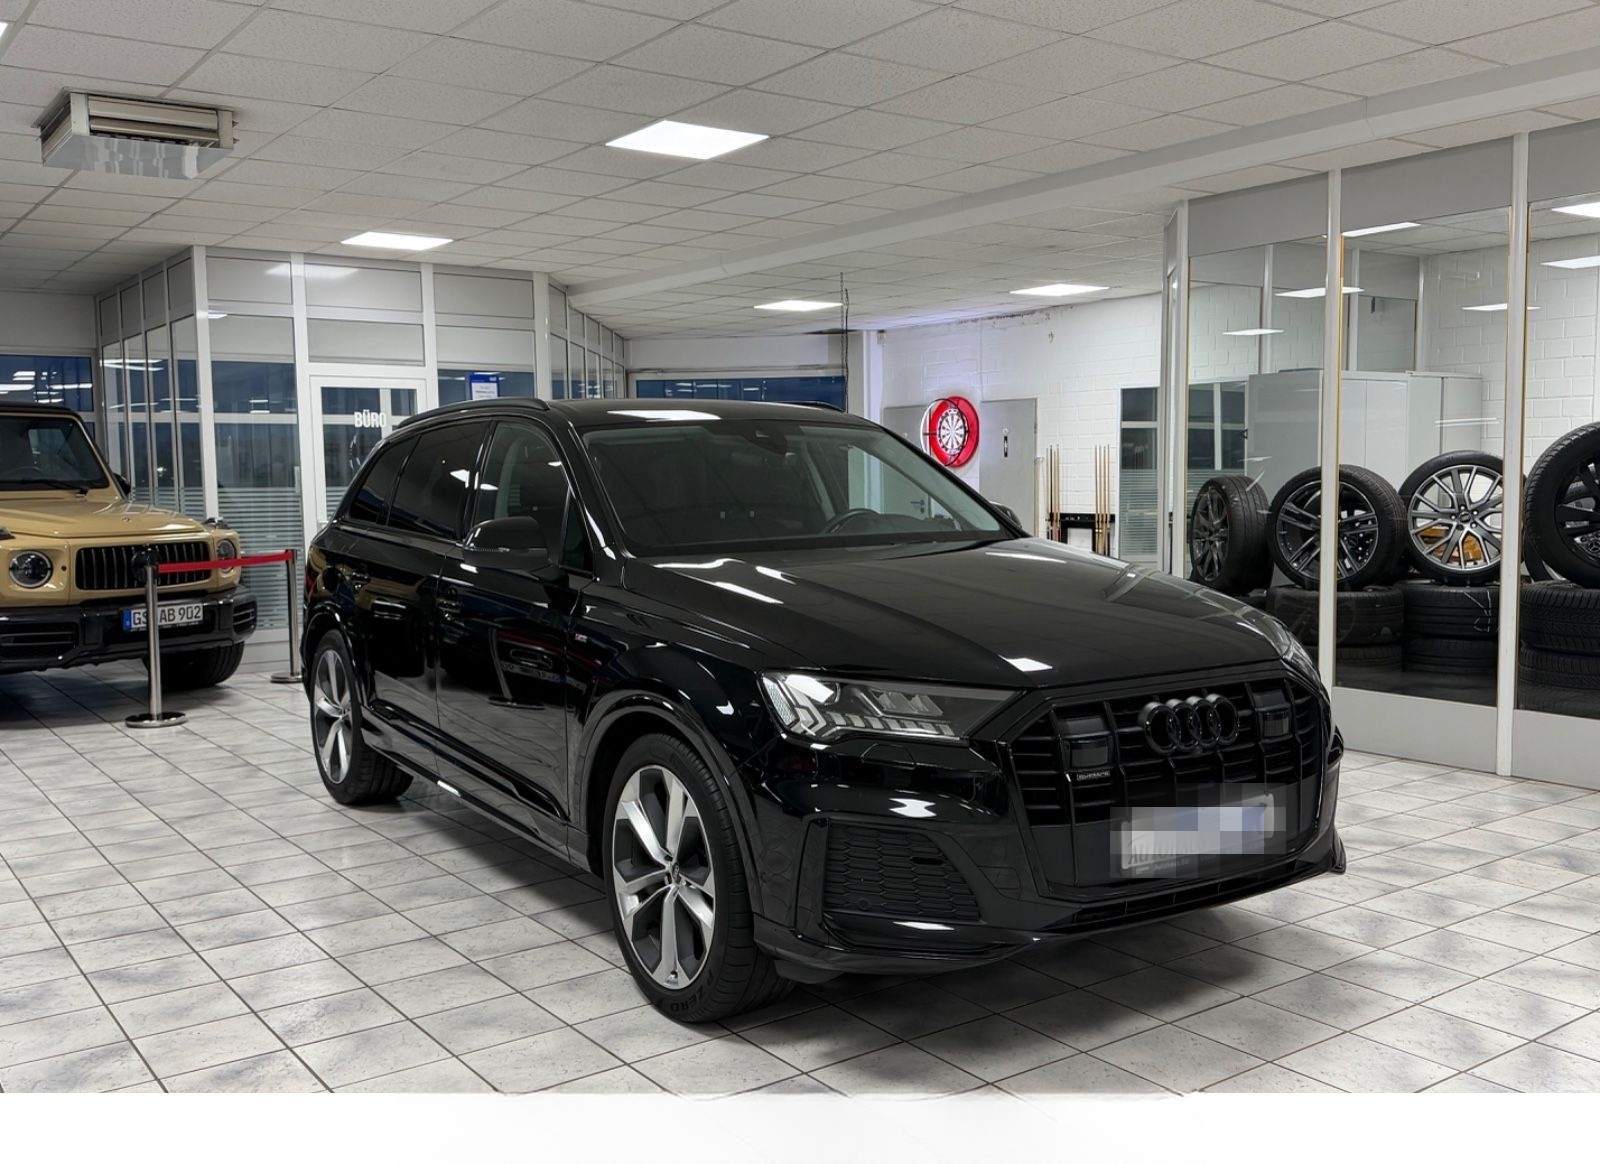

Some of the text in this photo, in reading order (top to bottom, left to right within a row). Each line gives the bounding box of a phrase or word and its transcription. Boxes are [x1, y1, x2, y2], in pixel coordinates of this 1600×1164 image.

[354, 409, 387, 428] BÜRO
[159, 607, 176, 624] AB
[178, 605, 201, 621] 902
